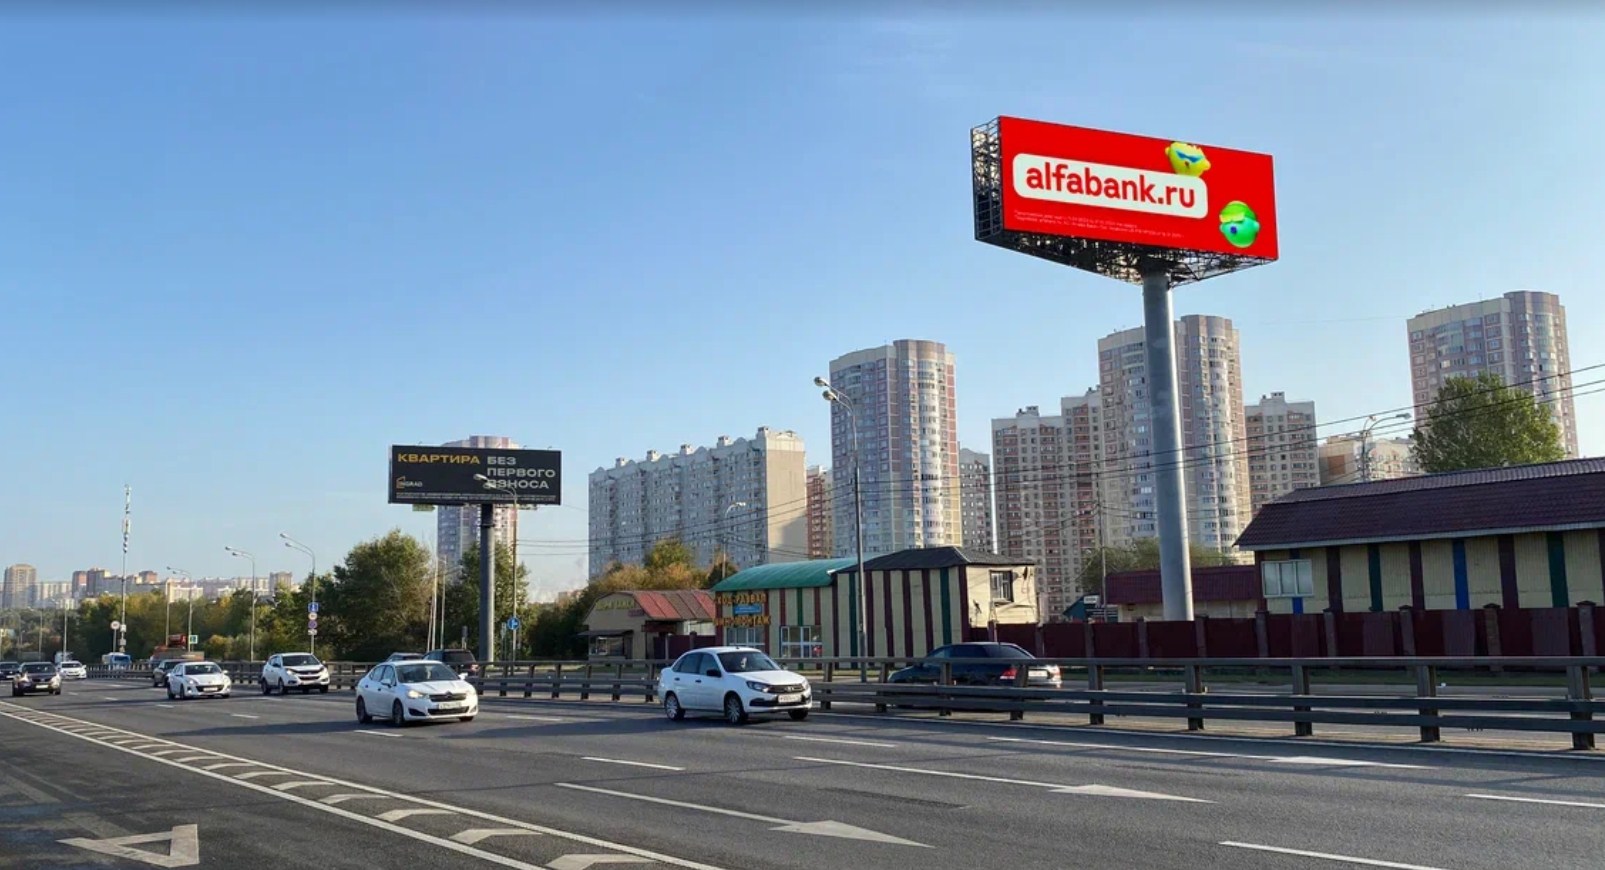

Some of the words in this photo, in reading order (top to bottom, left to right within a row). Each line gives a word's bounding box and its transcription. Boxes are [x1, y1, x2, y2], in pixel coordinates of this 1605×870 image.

[1025, 161, 1196, 209] alfabank.ru
[397, 453, 481, 465] КВАРТИРА
[486, 456, 517, 465] БЕЗ
[486, 467, 556, 478] ПЕРВОГО
